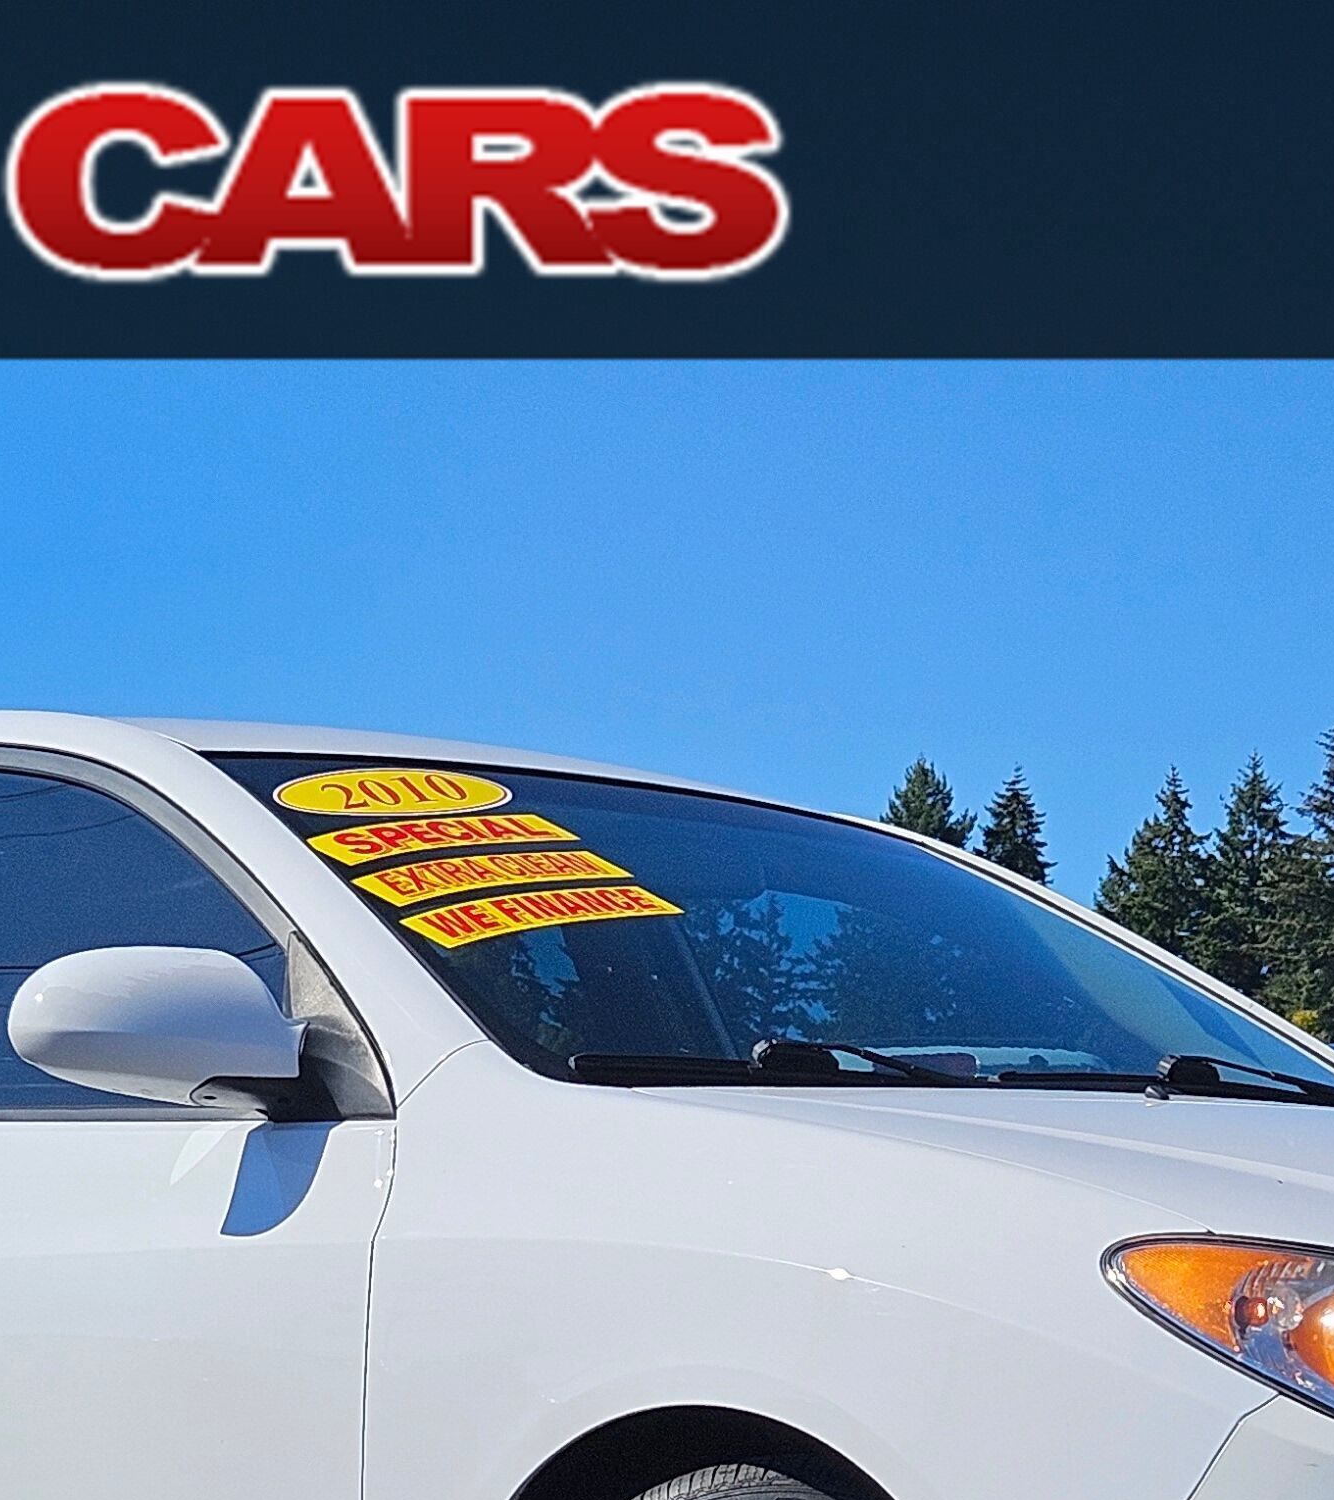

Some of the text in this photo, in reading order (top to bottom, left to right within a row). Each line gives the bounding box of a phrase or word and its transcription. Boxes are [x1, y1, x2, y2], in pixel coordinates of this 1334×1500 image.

[321, 772, 467, 810] 2010
[333, 816, 554, 855] SPECIAL
[378, 850, 599, 897] EXTRA CLEAN
[421, 888, 659, 940] WE FINANCE
